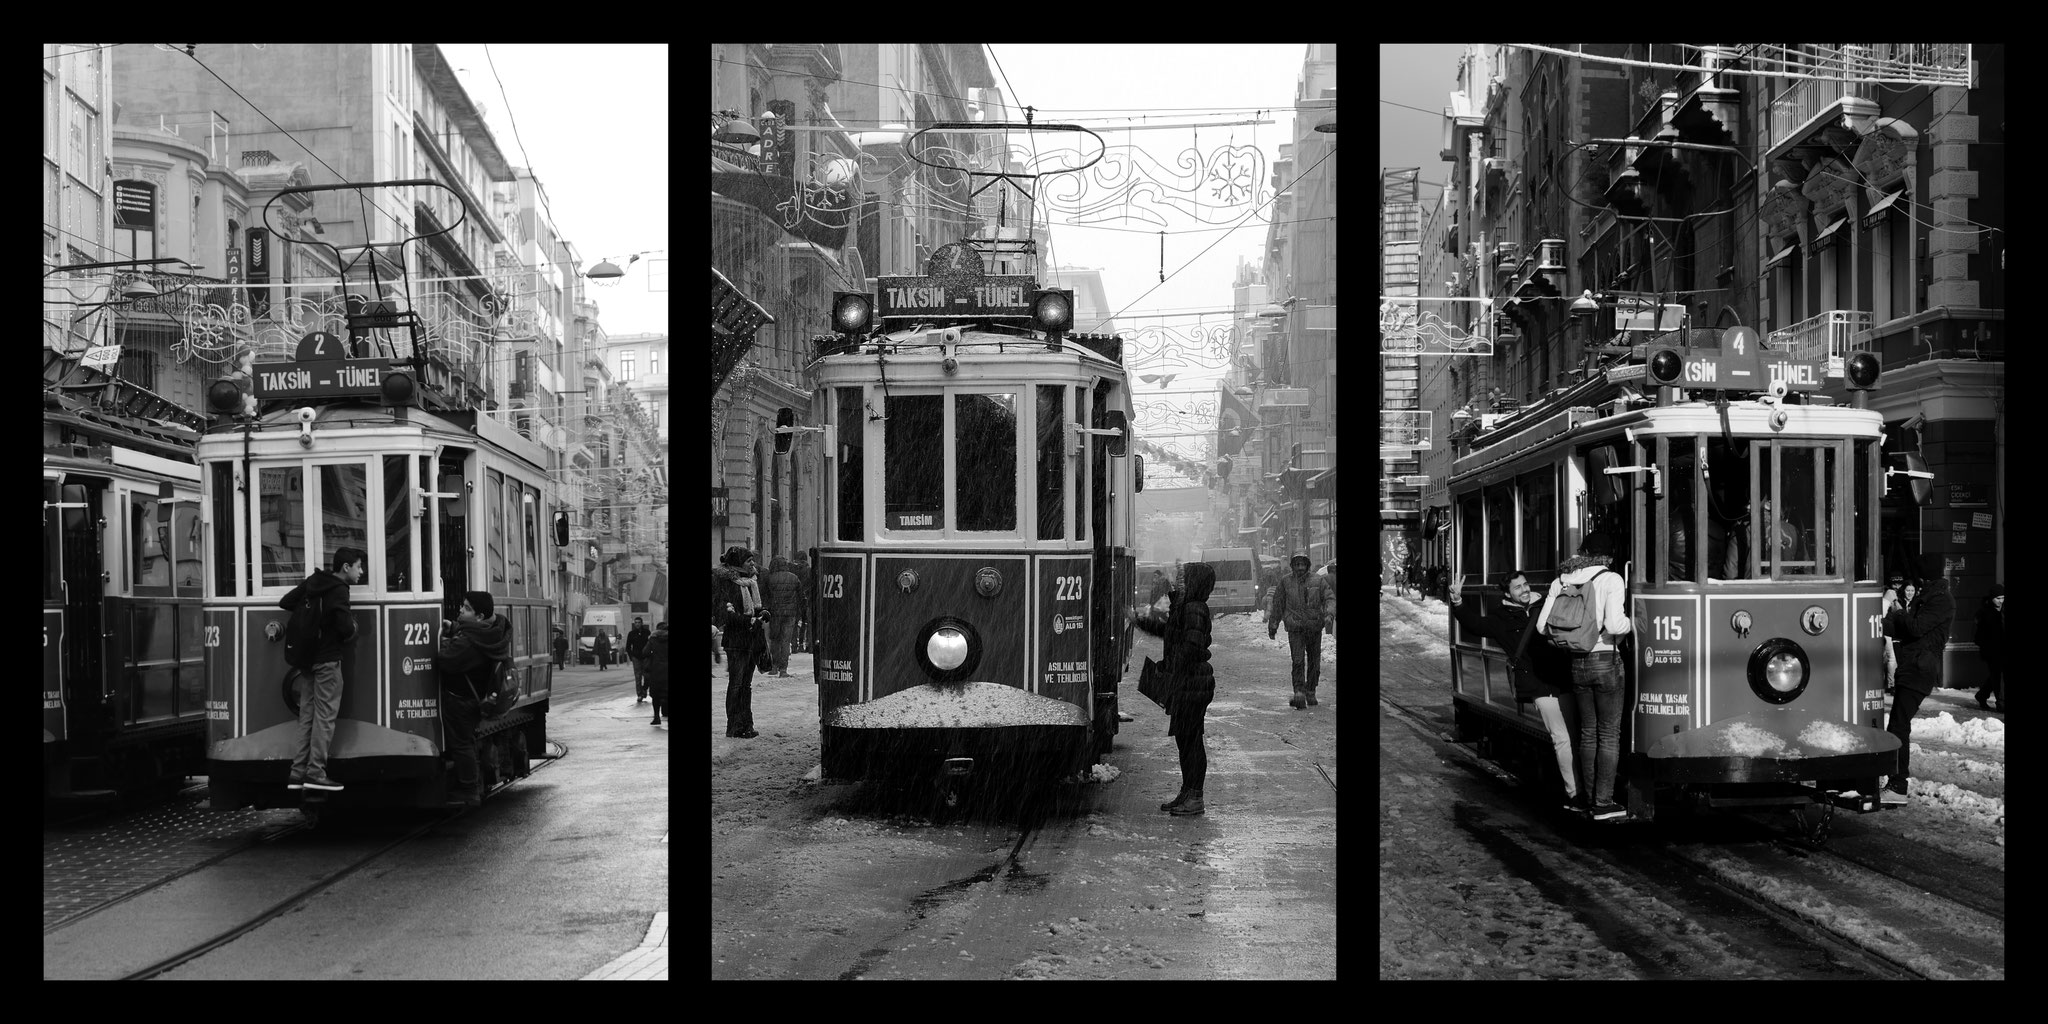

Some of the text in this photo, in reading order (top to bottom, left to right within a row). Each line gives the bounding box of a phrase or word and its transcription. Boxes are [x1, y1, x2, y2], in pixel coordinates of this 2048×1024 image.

[951, 245, 962, 269] 2
[886, 284, 945, 308] TAKSİM
[974, 284, 1030, 308] TÜNEL
[314, 334, 325, 355] 2
[1733, 332, 1744, 355] 4
[260, 368, 311, 391] TAKSİM
[336, 366, 381, 388] TÜNEL
[1767, 361, 1818, 385] TÜNEL
[899, 513, 933, 526] TAKSİM
[823, 574, 844, 599] 223
[1056, 575, 1082, 601] 223
[404, 622, 430, 646] 223
[1653, 615, 1682, 641] 115
[1047, 662, 1075, 672] ASILMAK
[1654, 656, 1682, 664] ALO 153
[1044, 673, 1054, 684] VE
[1646, 703, 1690, 716] TEHLİKELİDİR
[1665, 693, 1688, 704] YASAK
[395, 709, 405, 719] VE
